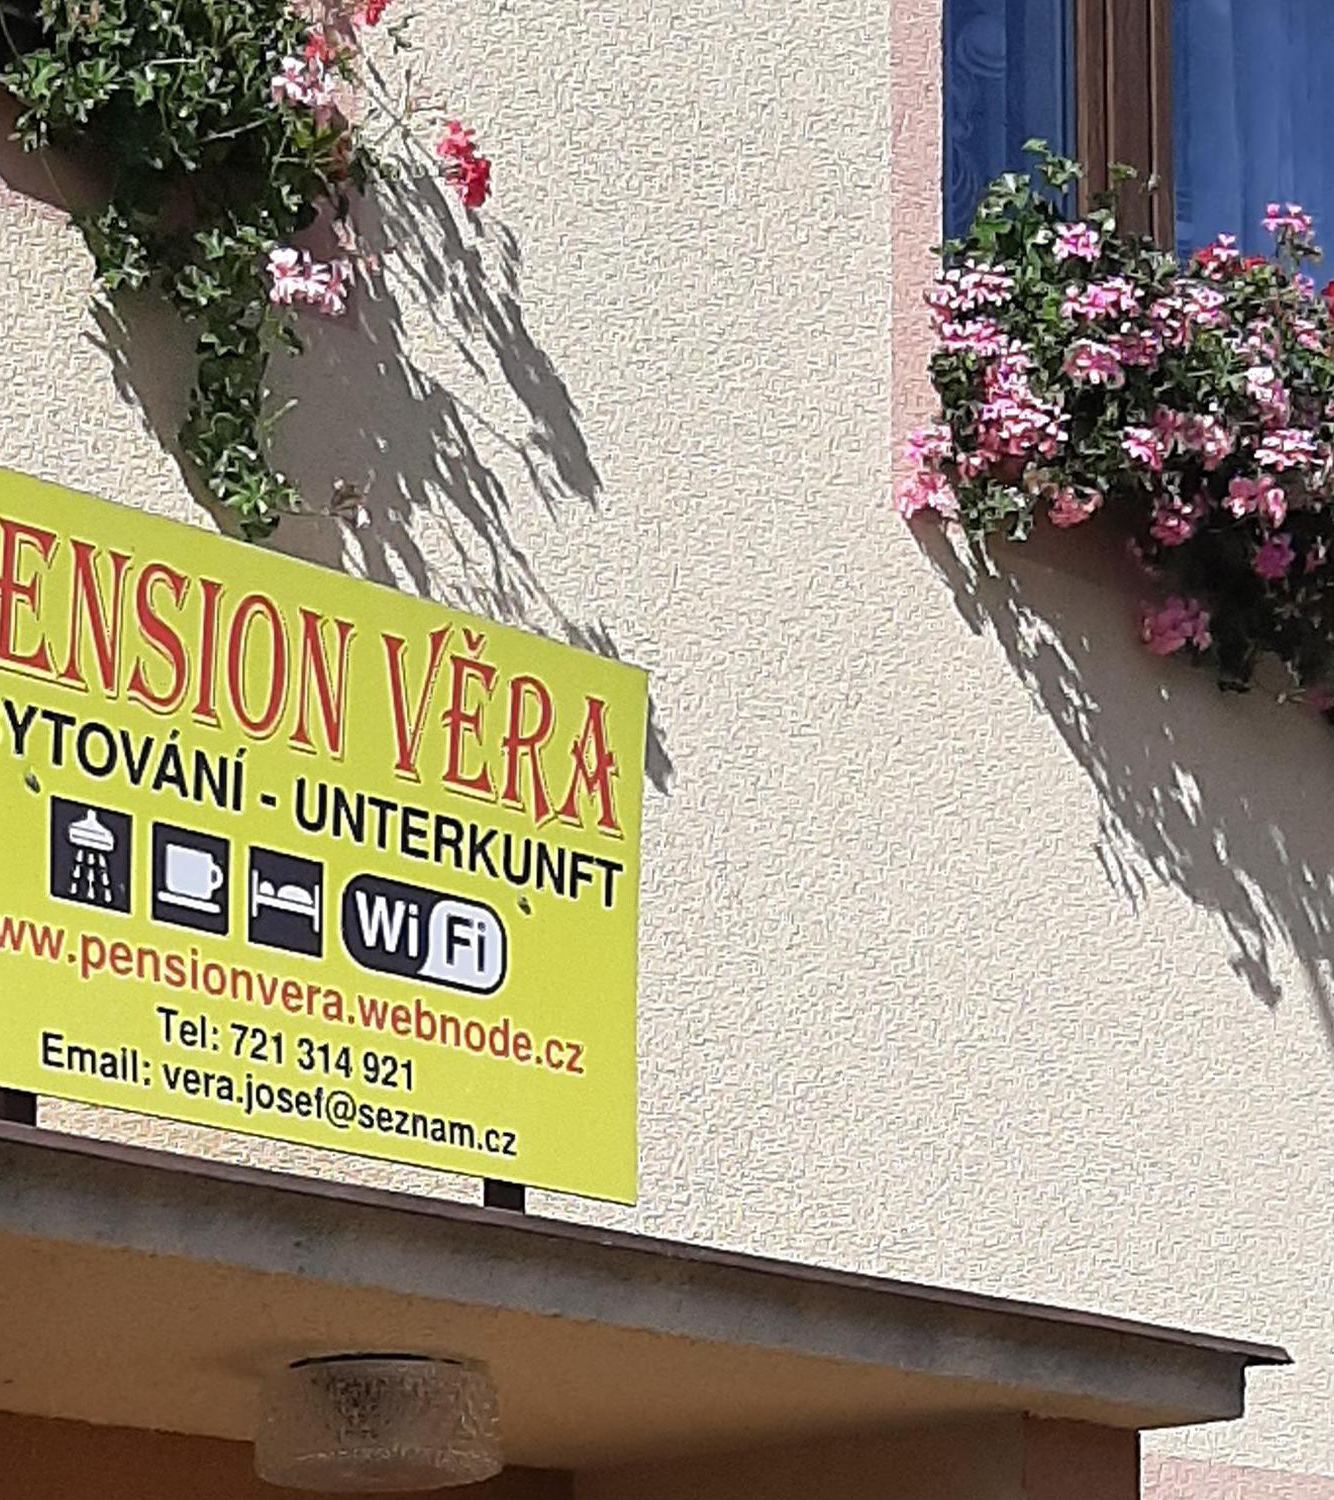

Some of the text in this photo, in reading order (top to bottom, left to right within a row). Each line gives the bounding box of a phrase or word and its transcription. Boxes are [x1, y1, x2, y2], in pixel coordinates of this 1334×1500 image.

[381, 625, 625, 838] VĚRA
[295, 777, 625, 908] UNTERKUNFT
[41, 1031, 518, 1158] Email: vera.josef@seznam.cz
[156, 1006, 415, 1092] Tel: 721 314 921
